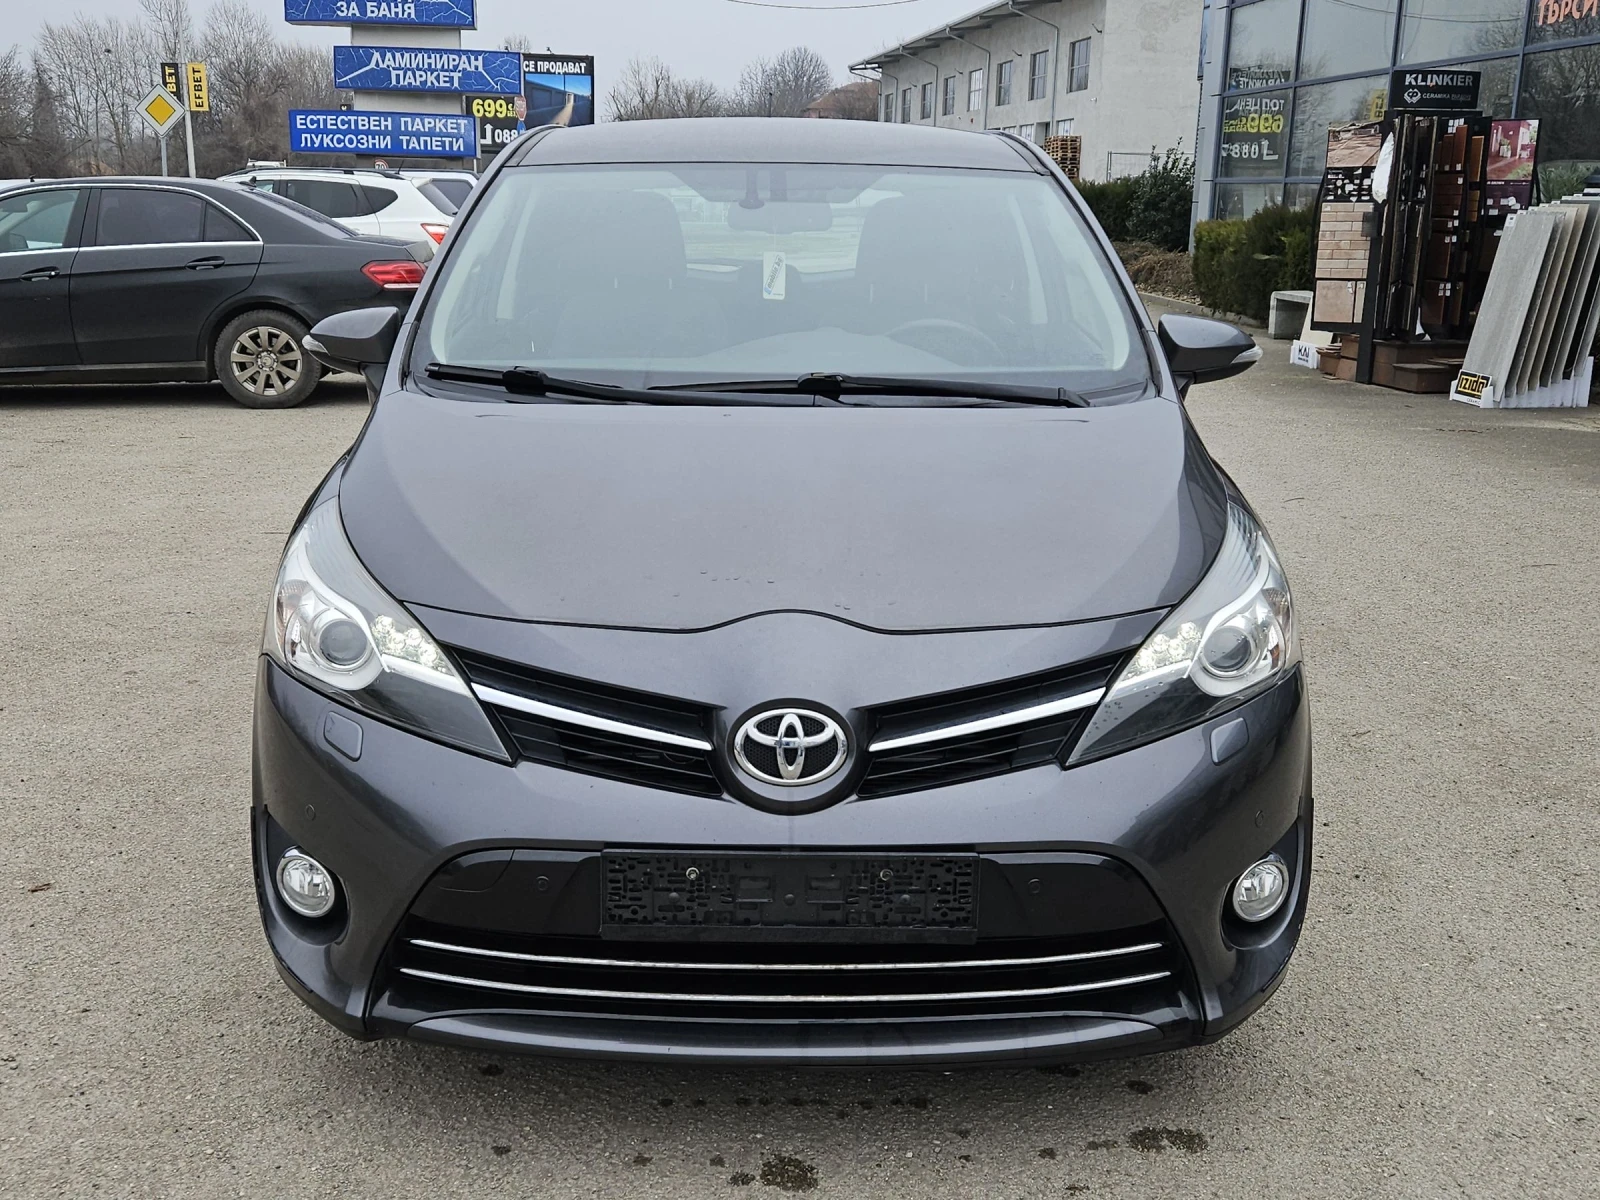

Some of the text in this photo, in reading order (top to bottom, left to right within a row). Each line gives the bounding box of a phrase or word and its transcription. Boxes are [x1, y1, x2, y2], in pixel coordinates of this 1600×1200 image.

[336, 2, 415, 19] ЗА БАНЯ
[370, 51, 483, 71] ЛАМИНИРАН
[523, 60, 586, 74] СЕ ПРОДАВАТ
[192, 66, 204, 108] EFBET
[391, 70, 462, 88] ПАРКЕТ
[1404, 73, 1473, 87] KLINKIER
[472, 99, 507, 118] 699
[296, 115, 467, 133] ЕСТЕСТВЕН ПАРКЕТ
[300, 134, 464, 151] ЛУКСОЗНИ ТАПЕТИ
